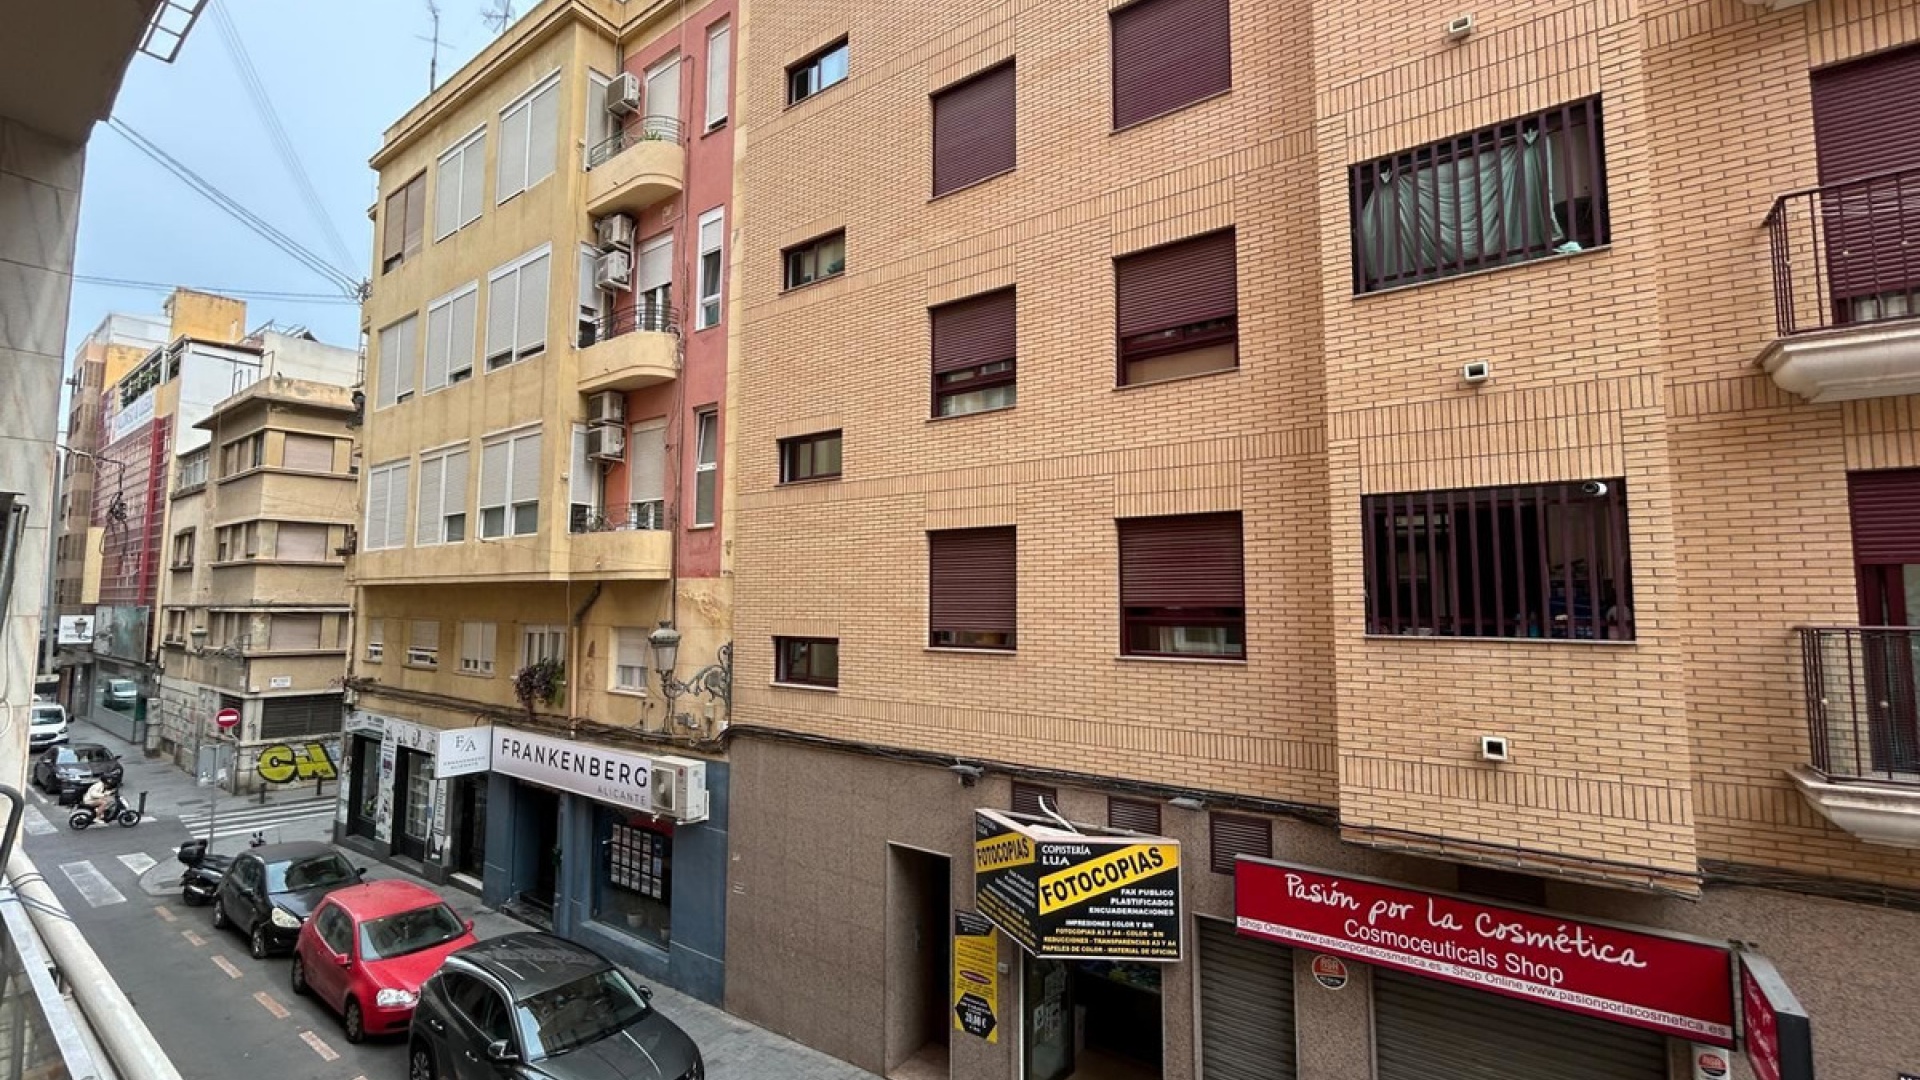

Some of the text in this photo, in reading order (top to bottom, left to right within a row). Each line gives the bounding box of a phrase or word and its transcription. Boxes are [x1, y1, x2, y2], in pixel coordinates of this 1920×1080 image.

[501, 737, 648, 788] FRANKENBERG
[597, 785, 647, 806] ALICANTE
[977, 837, 1030, 867] FOTOCOPIAS
[1041, 844, 1092, 855] COPISTERÍA
[1042, 856, 1070, 866] LUA
[1040, 846, 1164, 907] FOTOCOPIAS
[1121, 888, 1137, 896] FAX
[1109, 897, 1175, 906] PLASTIFICADOS
[1088, 907, 1175, 916] ENCUADERNACIONES
[1065, 919, 1111, 928] IMPRESIONES
[1112, 920, 1135, 928] COLOR
[1284, 873, 1361, 911] Pasión
[1367, 899, 1414, 925] por
[1474, 911, 1648, 968] Cosmética
[1055, 928, 1096, 936] FOTOCOPIAS
[1126, 930, 1148, 938] COLOR
[1042, 936, 1089, 944] REDUCCIONES
[1093, 938, 1150, 946] TRANSPARENCIAS
[1042, 945, 1070, 953] PAPELES
[1071, 945, 1080, 953] DE
[1108, 947, 1139, 955] MATERIAL
[1140, 947, 1150, 955] DE
[1151, 948, 1178, 956] OFICINA
[1344, 918, 1564, 986] Cosmoceuticals Shop
[1239, 917, 1262, 931] Shop
[1263, 922, 1294, 938] Online
[1294, 930, 1443, 972] www.pasionporlacosmetica.es
[1452, 965, 1482, 982] Shop
[1484, 973, 1524, 991] Online
[1525, 983, 1727, 1038] www.pasionporlacosmetica.es
